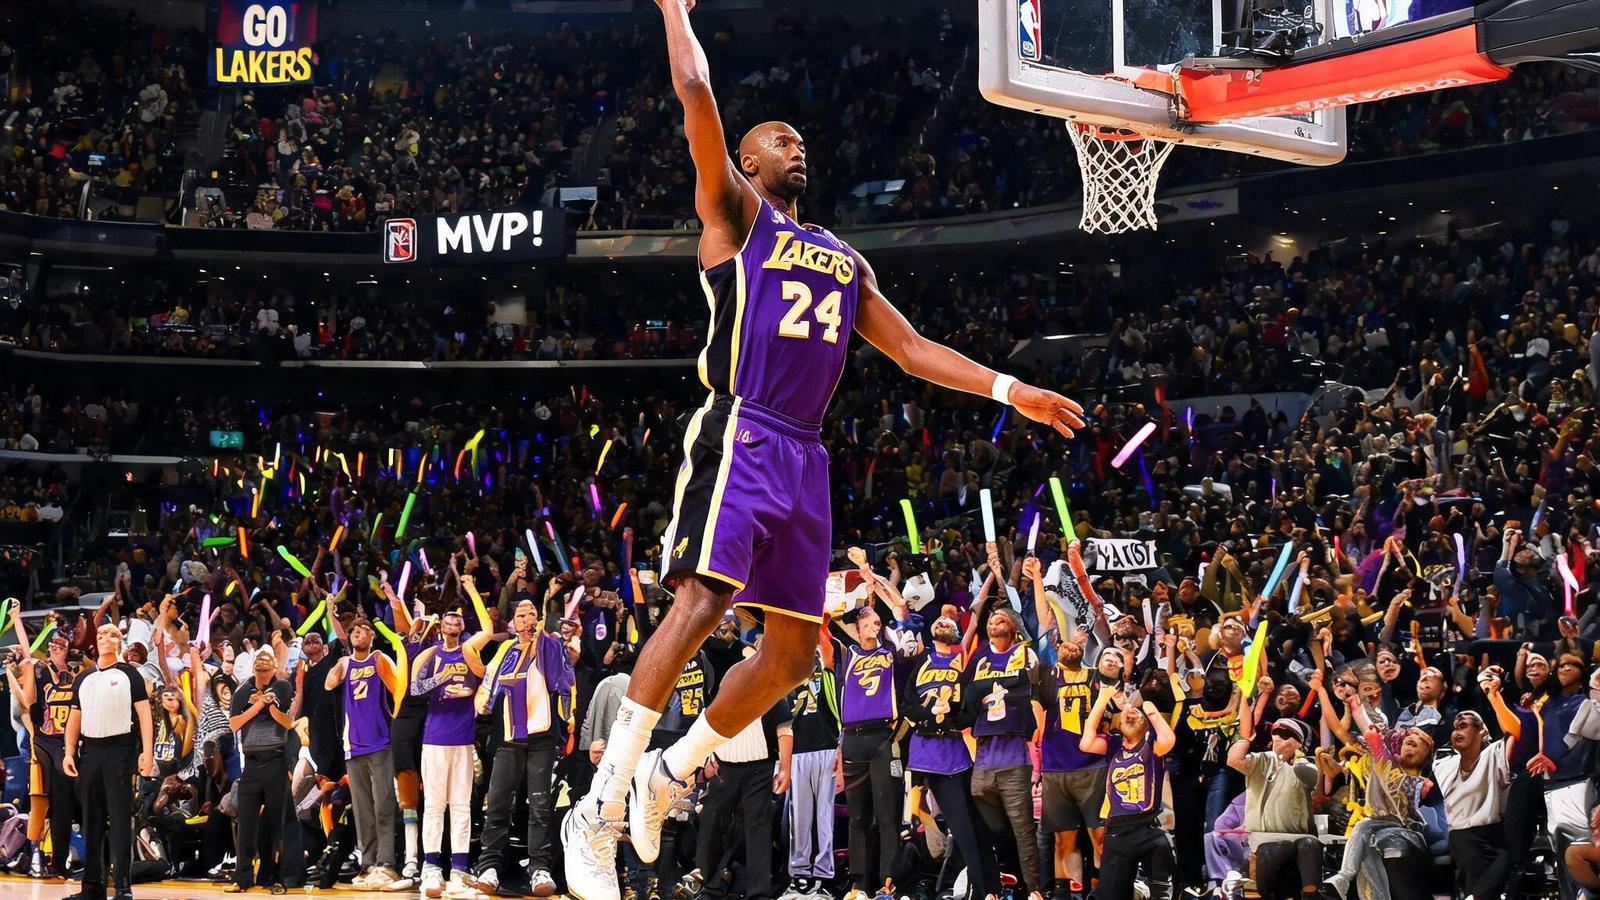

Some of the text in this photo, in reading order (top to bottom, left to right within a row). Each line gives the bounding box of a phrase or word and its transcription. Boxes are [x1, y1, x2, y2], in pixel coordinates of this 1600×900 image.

[243, 4, 287, 47] GO
[215, 47, 312, 83] LAKERS
[437, 210, 543, 255] MVP!
[762, 231, 854, 285] LAKERS
[778, 281, 842, 344] 24
